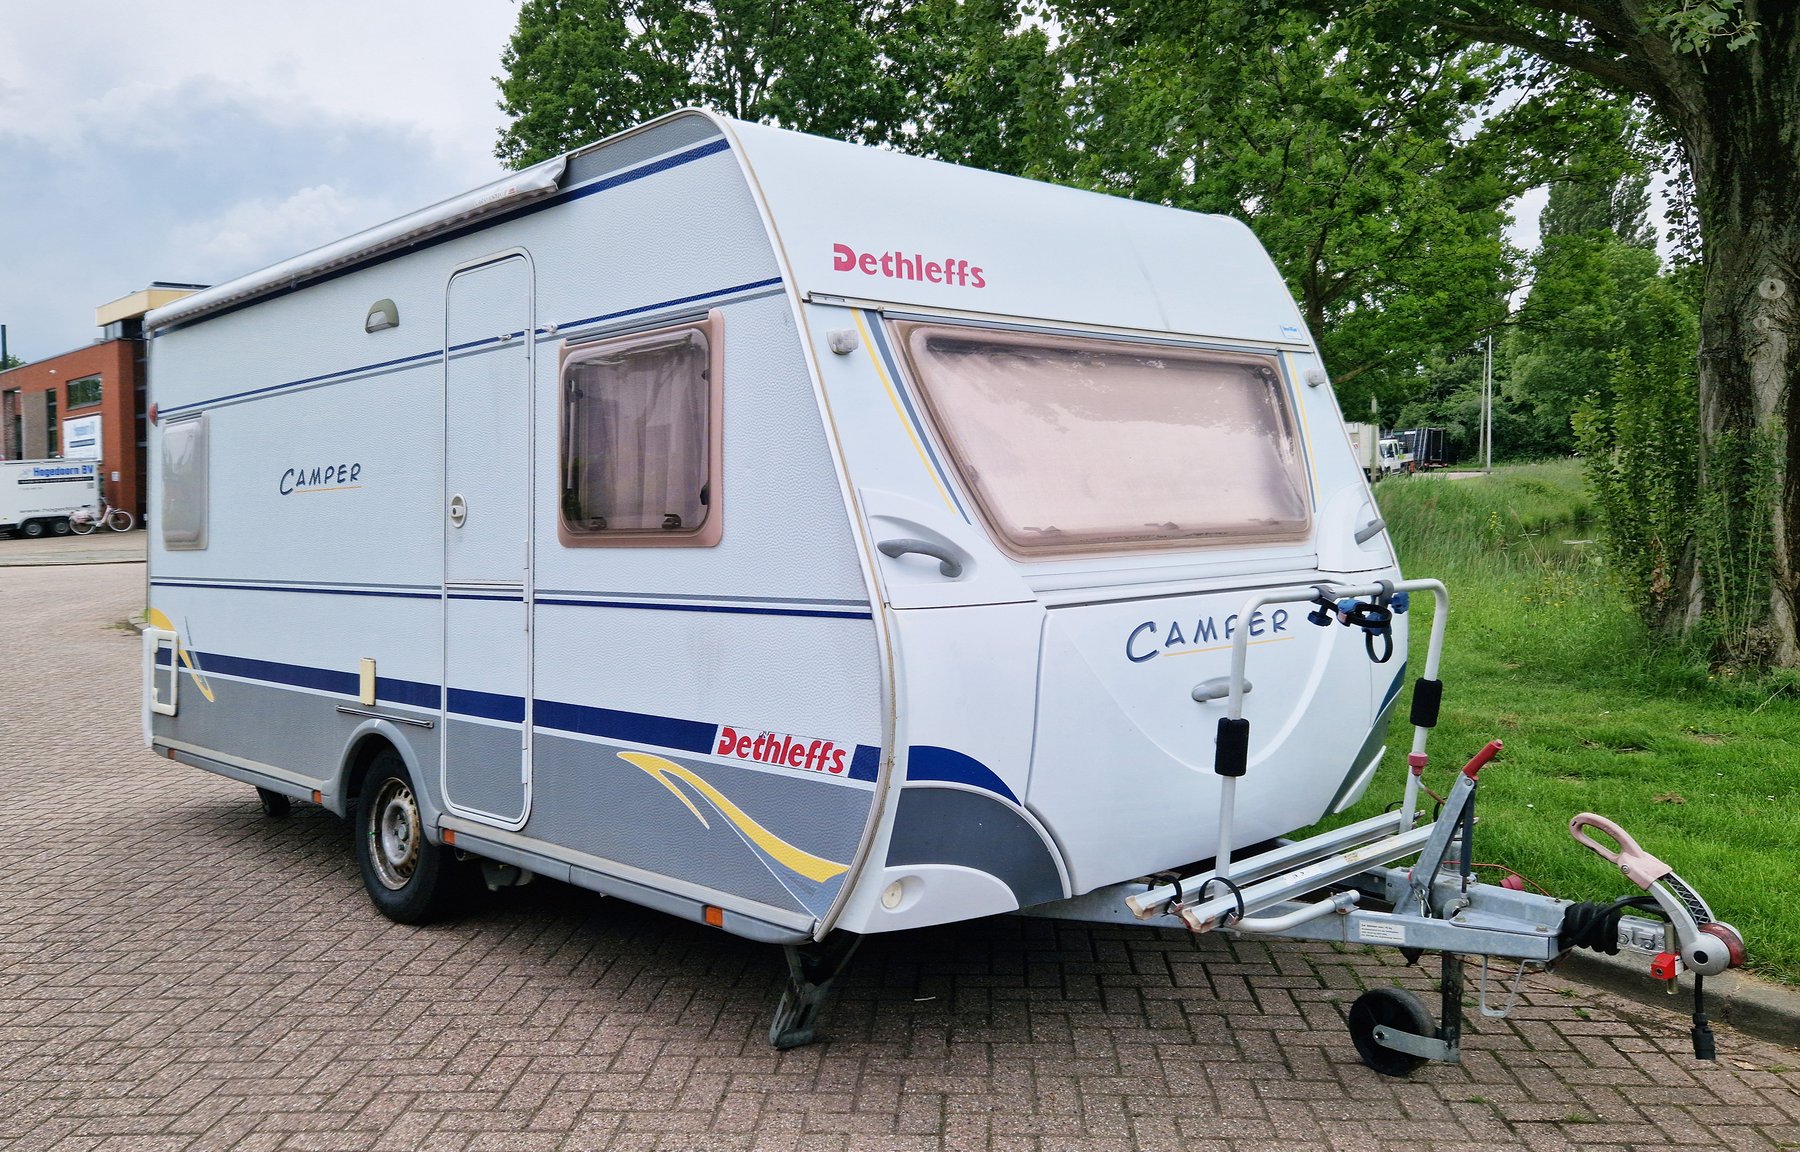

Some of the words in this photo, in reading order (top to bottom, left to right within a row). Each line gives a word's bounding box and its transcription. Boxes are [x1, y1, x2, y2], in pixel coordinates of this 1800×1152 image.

[833, 243, 986, 288] Dethleffs
[82, 464, 94, 475] BV
[279, 462, 361, 496] CAMPER
[717, 726, 847, 775] Dethleffs
